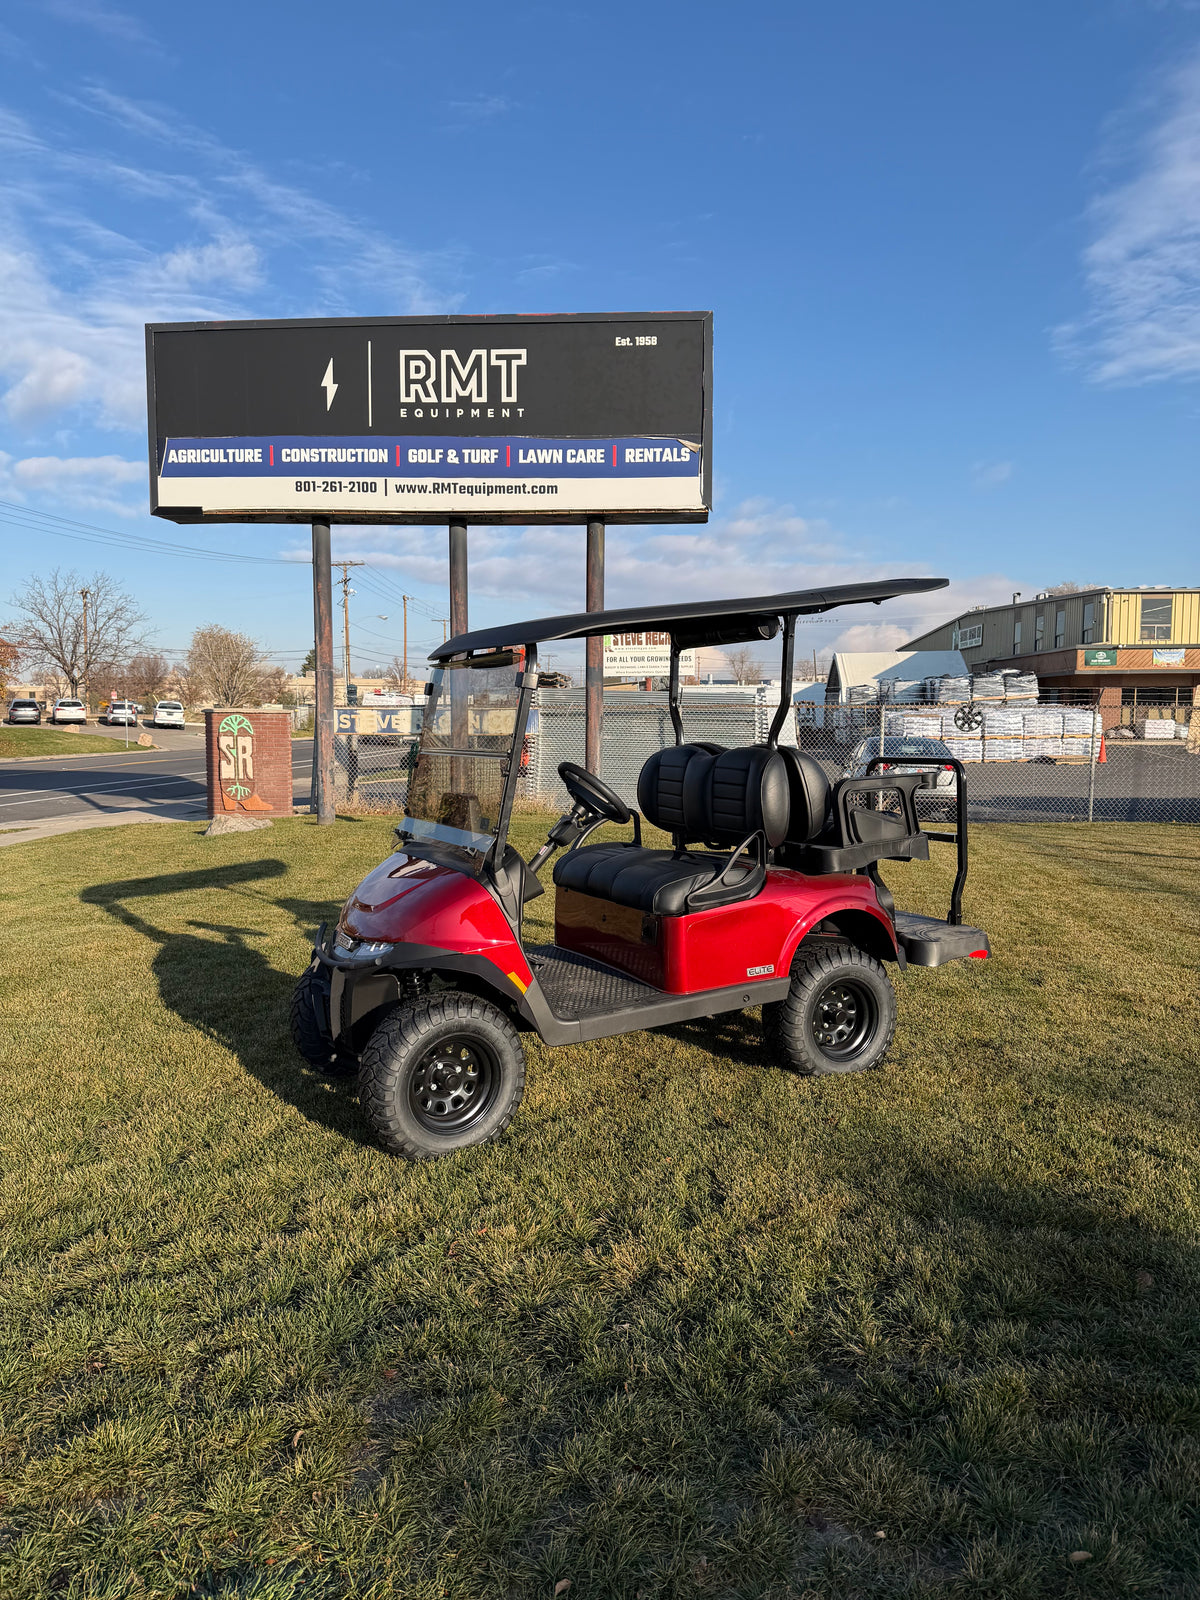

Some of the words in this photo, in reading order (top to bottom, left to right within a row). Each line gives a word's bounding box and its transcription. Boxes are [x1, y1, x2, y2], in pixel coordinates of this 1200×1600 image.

[615, 336, 633, 346] Est.
[635, 336, 657, 346] 1958
[399, 348, 527, 402] RMT
[400, 408, 525, 418] EQUIPMENT
[167, 448, 263, 464] AGRICULTURE
[281, 448, 389, 463] CONSTRUCTION
[408, 448, 443, 464] GOLF
[446, 448, 460, 464] &
[462, 448, 499, 464] TURF
[518, 448, 563, 464] LAWN
[566, 448, 605, 464] CARE
[625, 447, 691, 463] RENTALS
[295, 480, 378, 493] 801-261-2100
[395, 482, 558, 496] www.RMTequipment.com
[613, 632, 643, 646] STEVE
[645, 632, 671, 645] REGA
[219, 736, 254, 780] SR
[748, 965, 773, 976] ELITE
